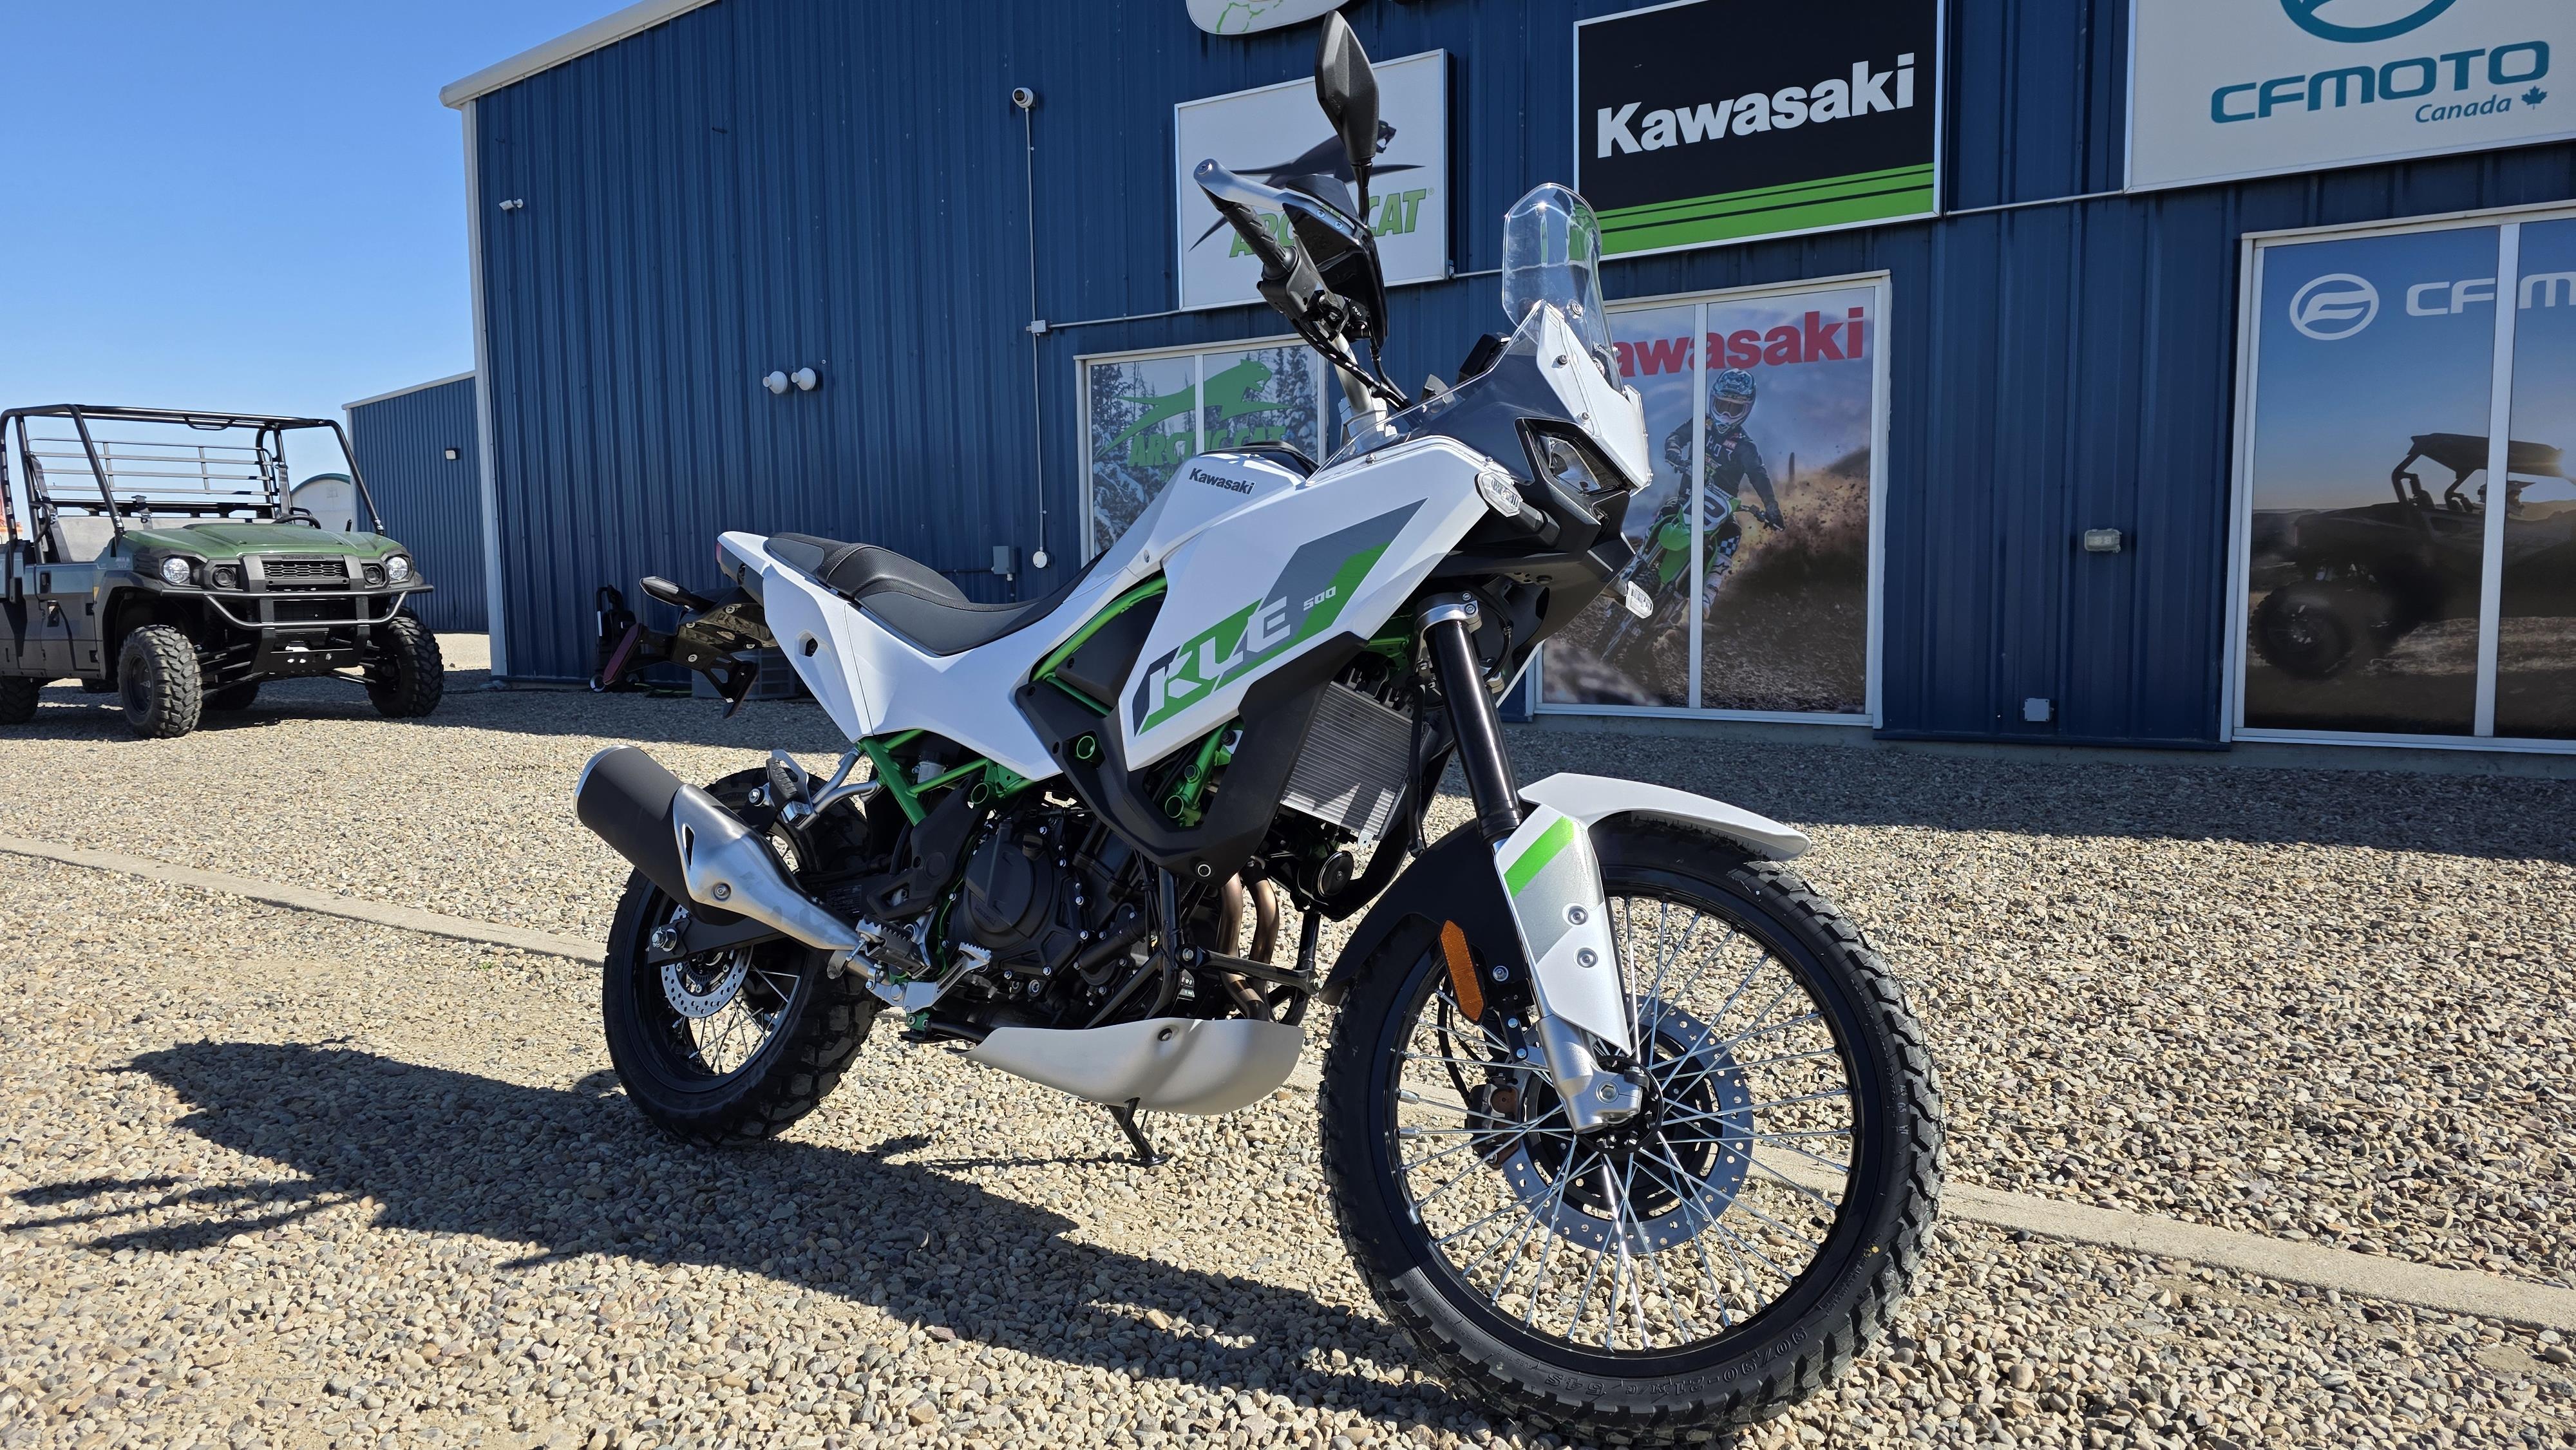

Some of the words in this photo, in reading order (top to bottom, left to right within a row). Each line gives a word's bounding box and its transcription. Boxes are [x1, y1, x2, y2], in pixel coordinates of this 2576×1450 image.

[1598, 52, 1915, 158] Kawasaki
[2211, 41, 2550, 124] CFMOTO
[2415, 95, 2512, 123] Canada
[1612, 306, 1864, 377] awasaki
[1189, 467, 1255, 495] Kawasaki
[1302, 585, 1337, 612] 500
[1148, 596, 1291, 712] KLE
